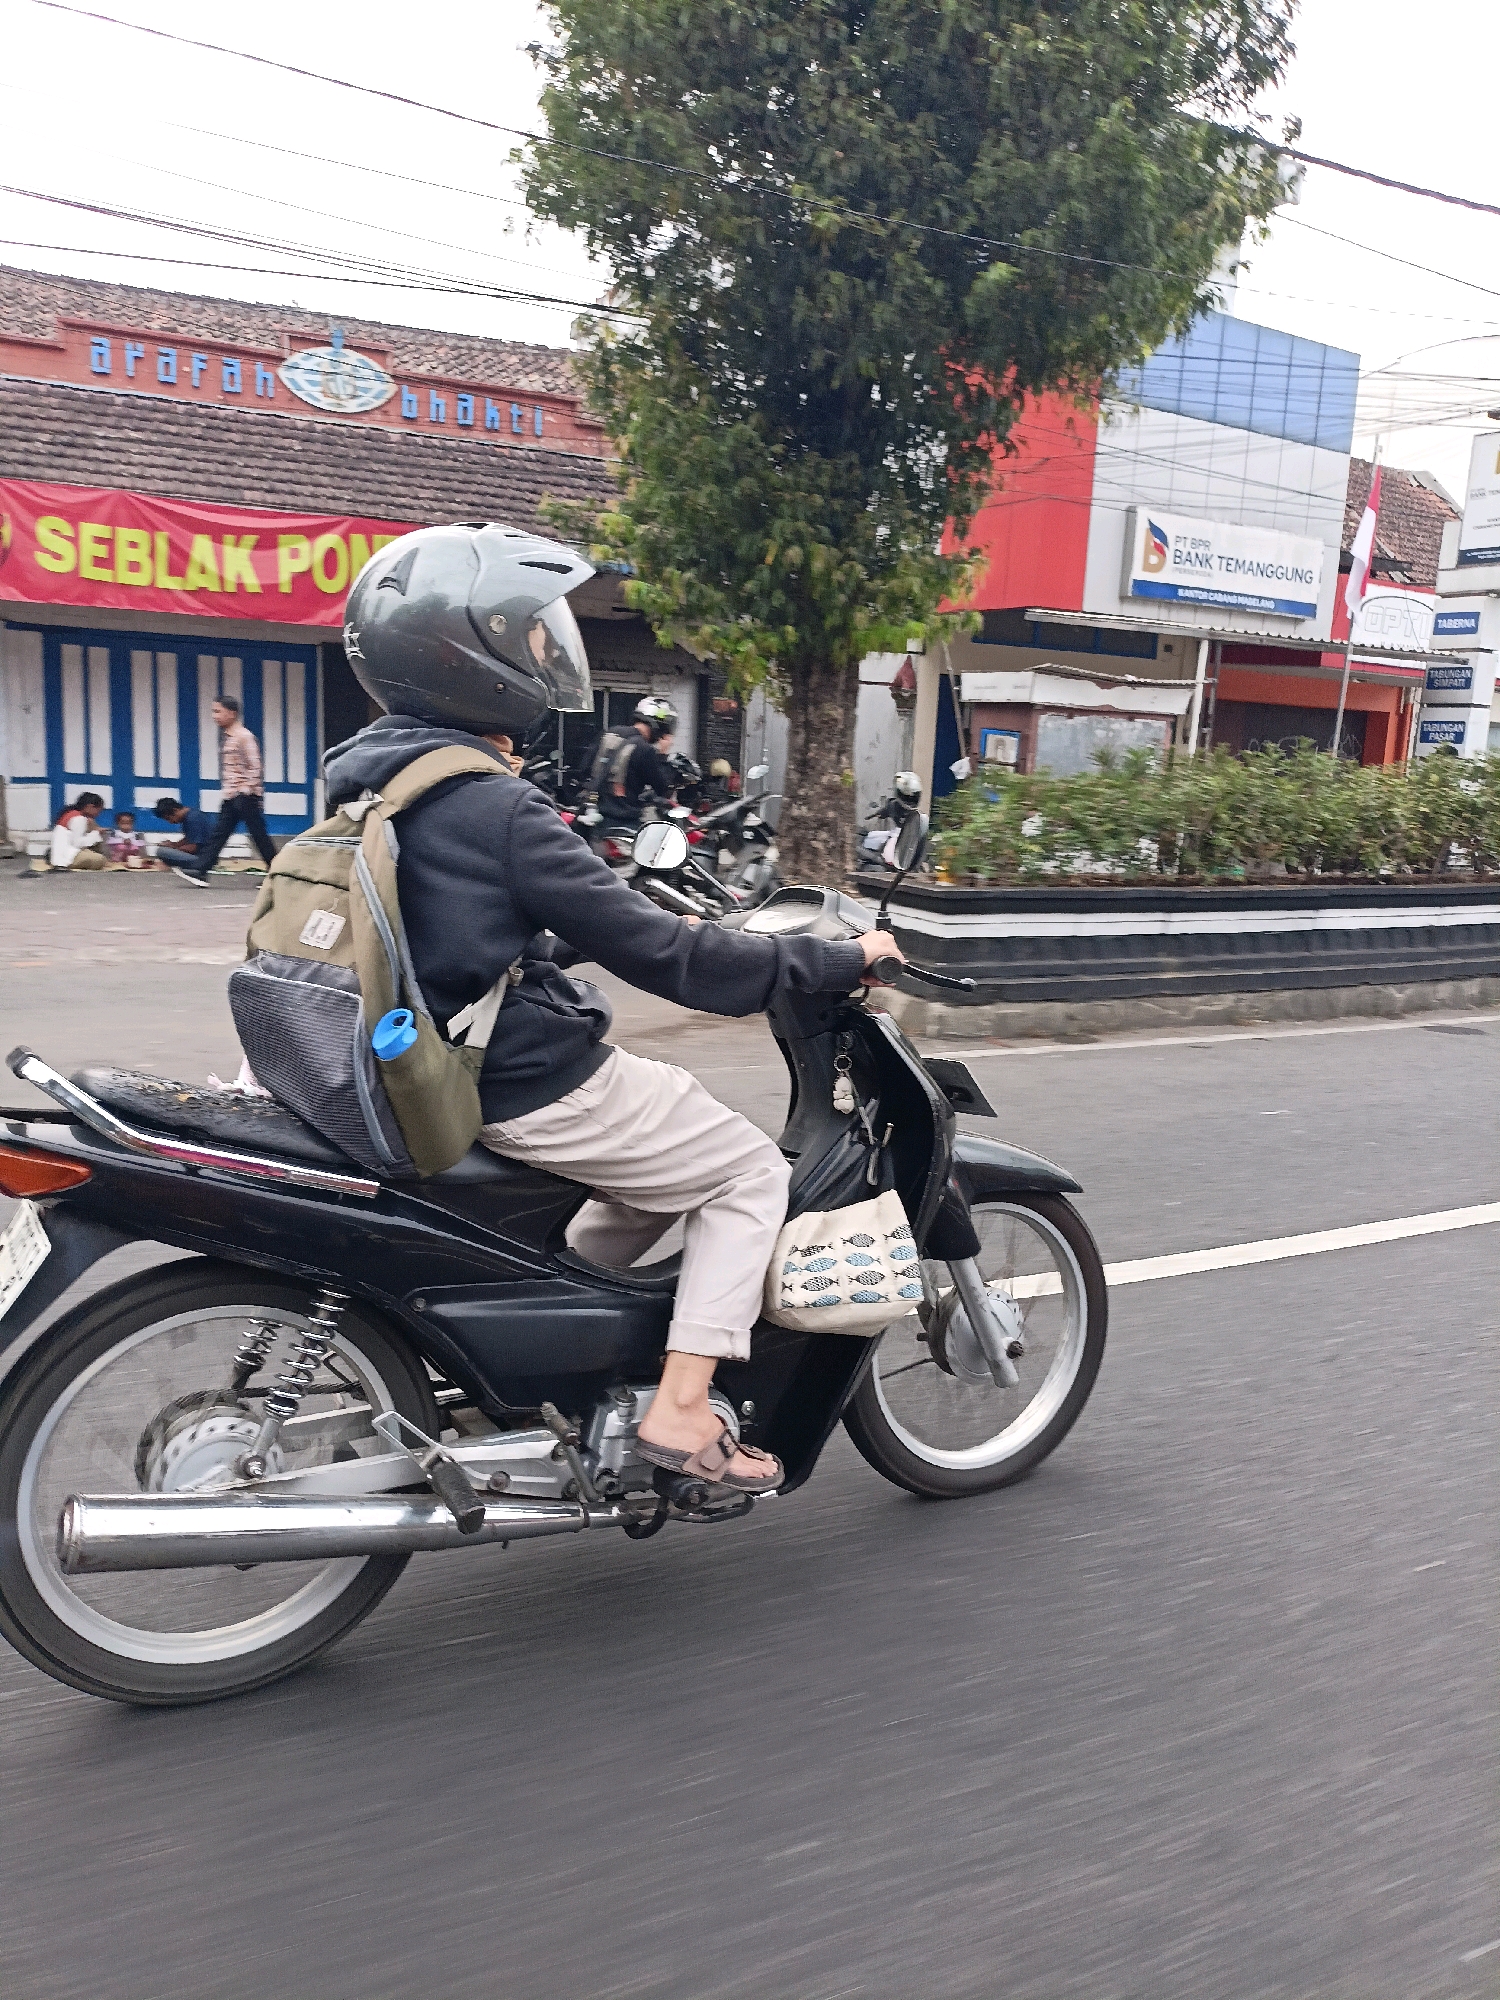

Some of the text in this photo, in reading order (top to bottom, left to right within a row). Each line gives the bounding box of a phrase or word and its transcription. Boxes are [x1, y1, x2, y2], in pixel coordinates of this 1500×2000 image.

[1175, 535, 1212, 551] PT BPR
[34, 515, 401, 594] SEBLAK PON
[1173, 549, 1314, 585] BANK TEMANGGUNG
[1364, 604, 1433, 641] OPTI
[1430, 669, 1472, 680] TABUNGAN
[1423, 723, 1464, 734] TABUNGAN
[1428, 732, 1456, 742] PASAR
